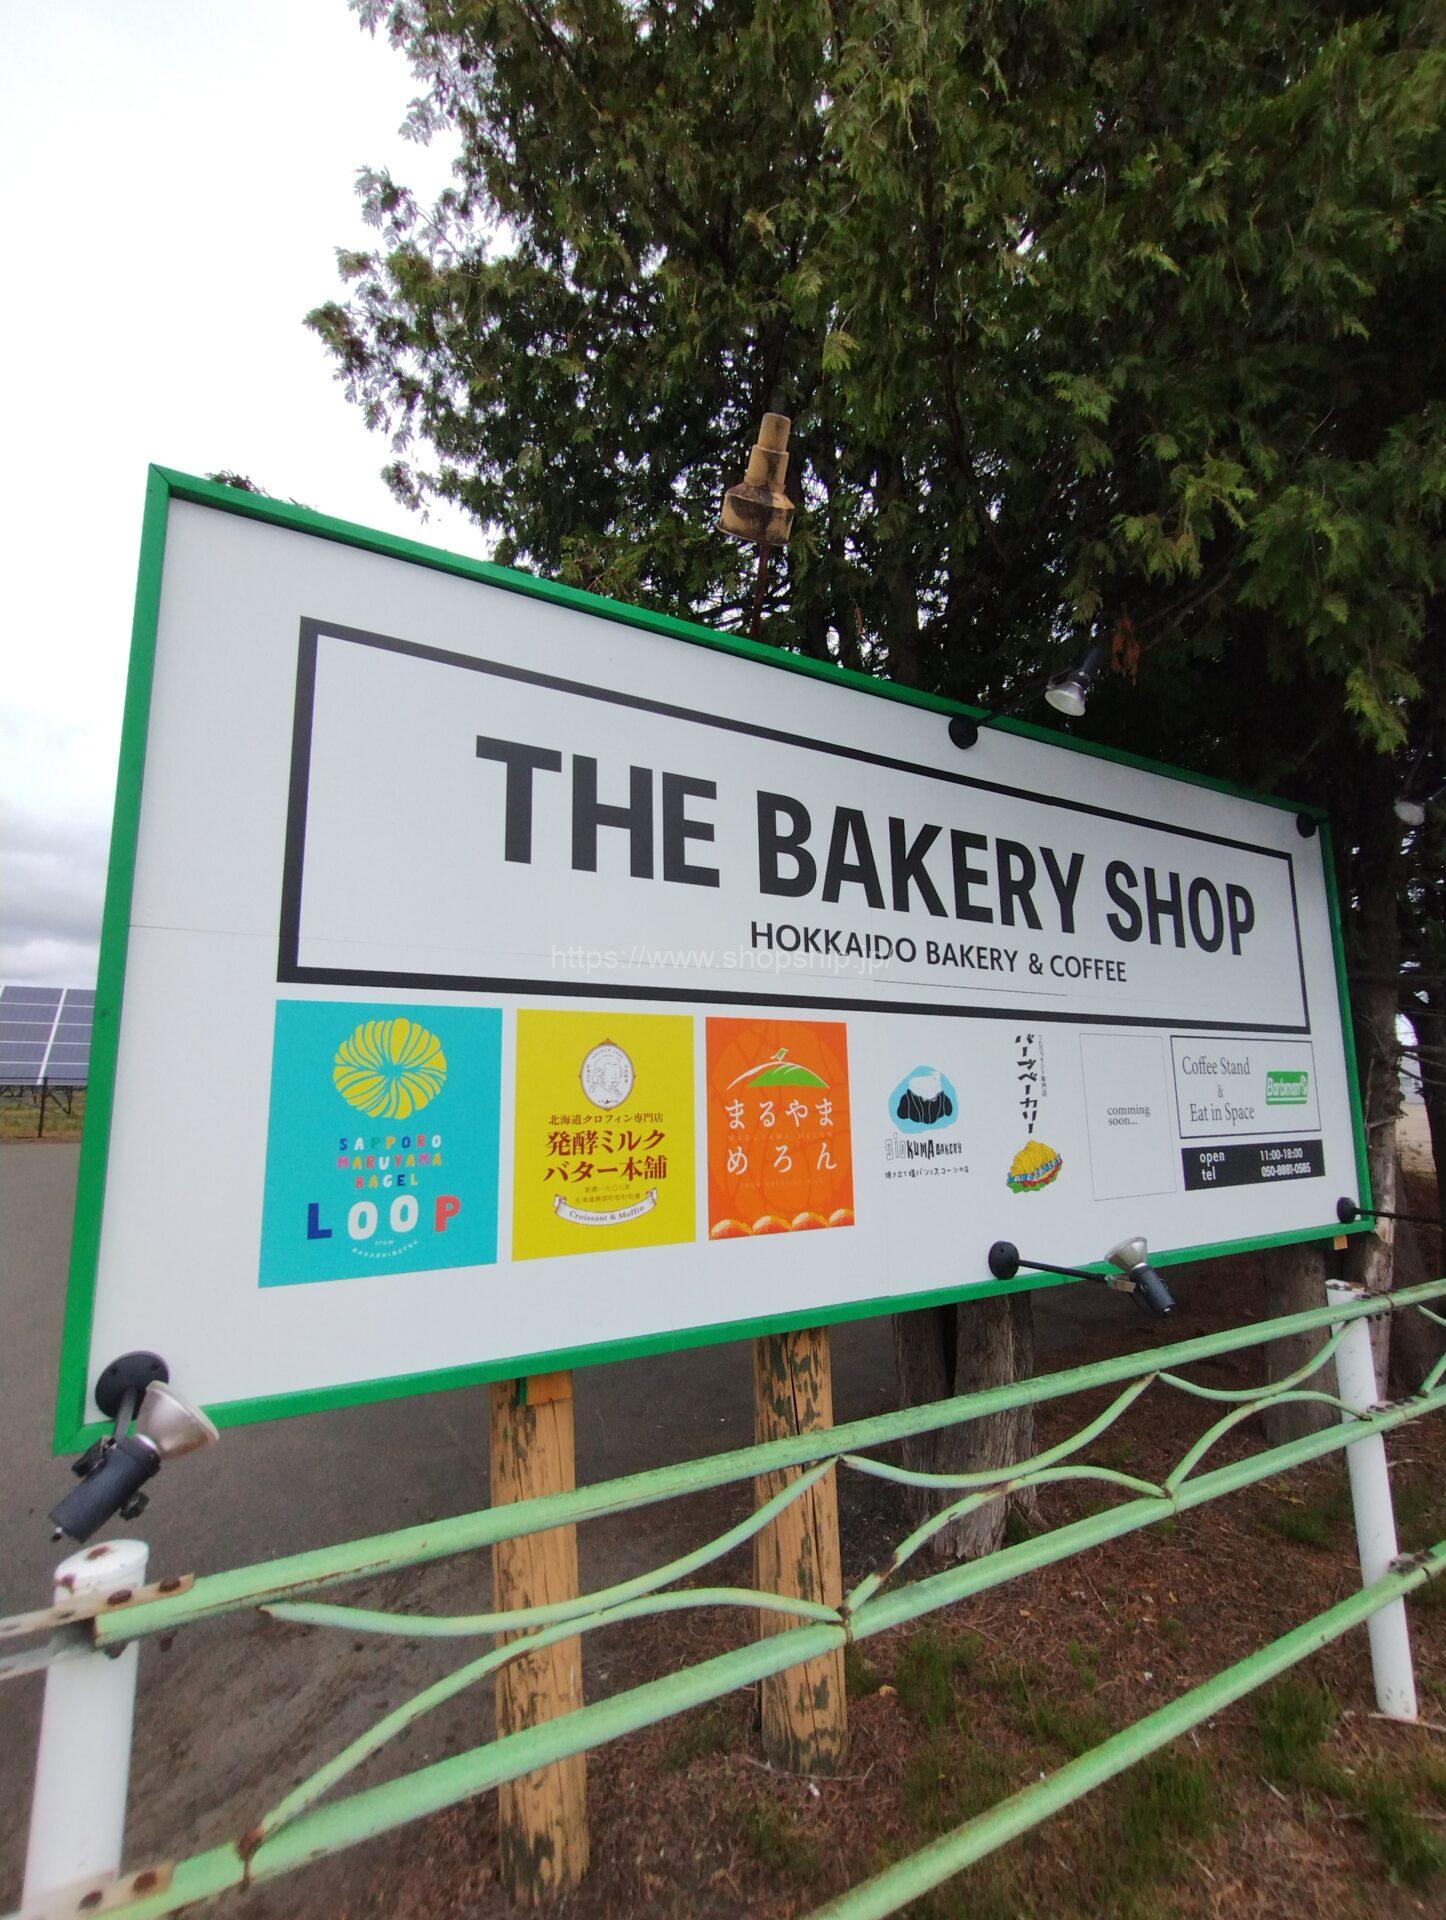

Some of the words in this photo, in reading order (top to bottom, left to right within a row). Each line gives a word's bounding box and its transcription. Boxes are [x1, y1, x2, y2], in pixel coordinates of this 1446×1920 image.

[476, 735, 720, 889] THE
[756, 790, 1086, 934] BAKERY
[1105, 859, 1256, 957] SHOP
[751, 922, 917, 964] HOKKAIDO
[926, 940, 1019, 972] BAKERY
[1028, 953, 1044, 975] &
[1050, 955, 1128, 982] COFFEE
[1182, 1056, 1218, 1075] Coffee
[1222, 1057, 1250, 1075] Stand
[1217, 1084, 1224, 1098] &
[548, 1112, 663, 1126] 北海道クロフィン専門店
[725, 1098, 833, 1129] まるやま
[1107, 1104, 1150, 1117] comming
[1189, 1104, 1209, 1122] Eat
[1212, 1103, 1222, 1121] in
[1225, 1103, 1255, 1126] Space
[1108, 1116, 1138, 1126] soon...
[339, 1133, 442, 1151] SAPPORO
[545, 1128, 666, 1158] 発酵ミルク
[337, 1153, 443, 1170] MARUYAMA
[727, 1141, 838, 1175] めろん
[1199, 1150, 1225, 1167] open
[1260, 1147, 1303, 1162] 11:00-18:00
[543, 1154, 668, 1183] バター本舗
[1202, 1165, 1216, 1181] tel
[355, 1173, 418, 1189] BAGEL
[307, 1194, 461, 1240] LOOP
[569, 1209, 607, 1221] Croissant
[619, 1205, 645, 1219] Muffin
